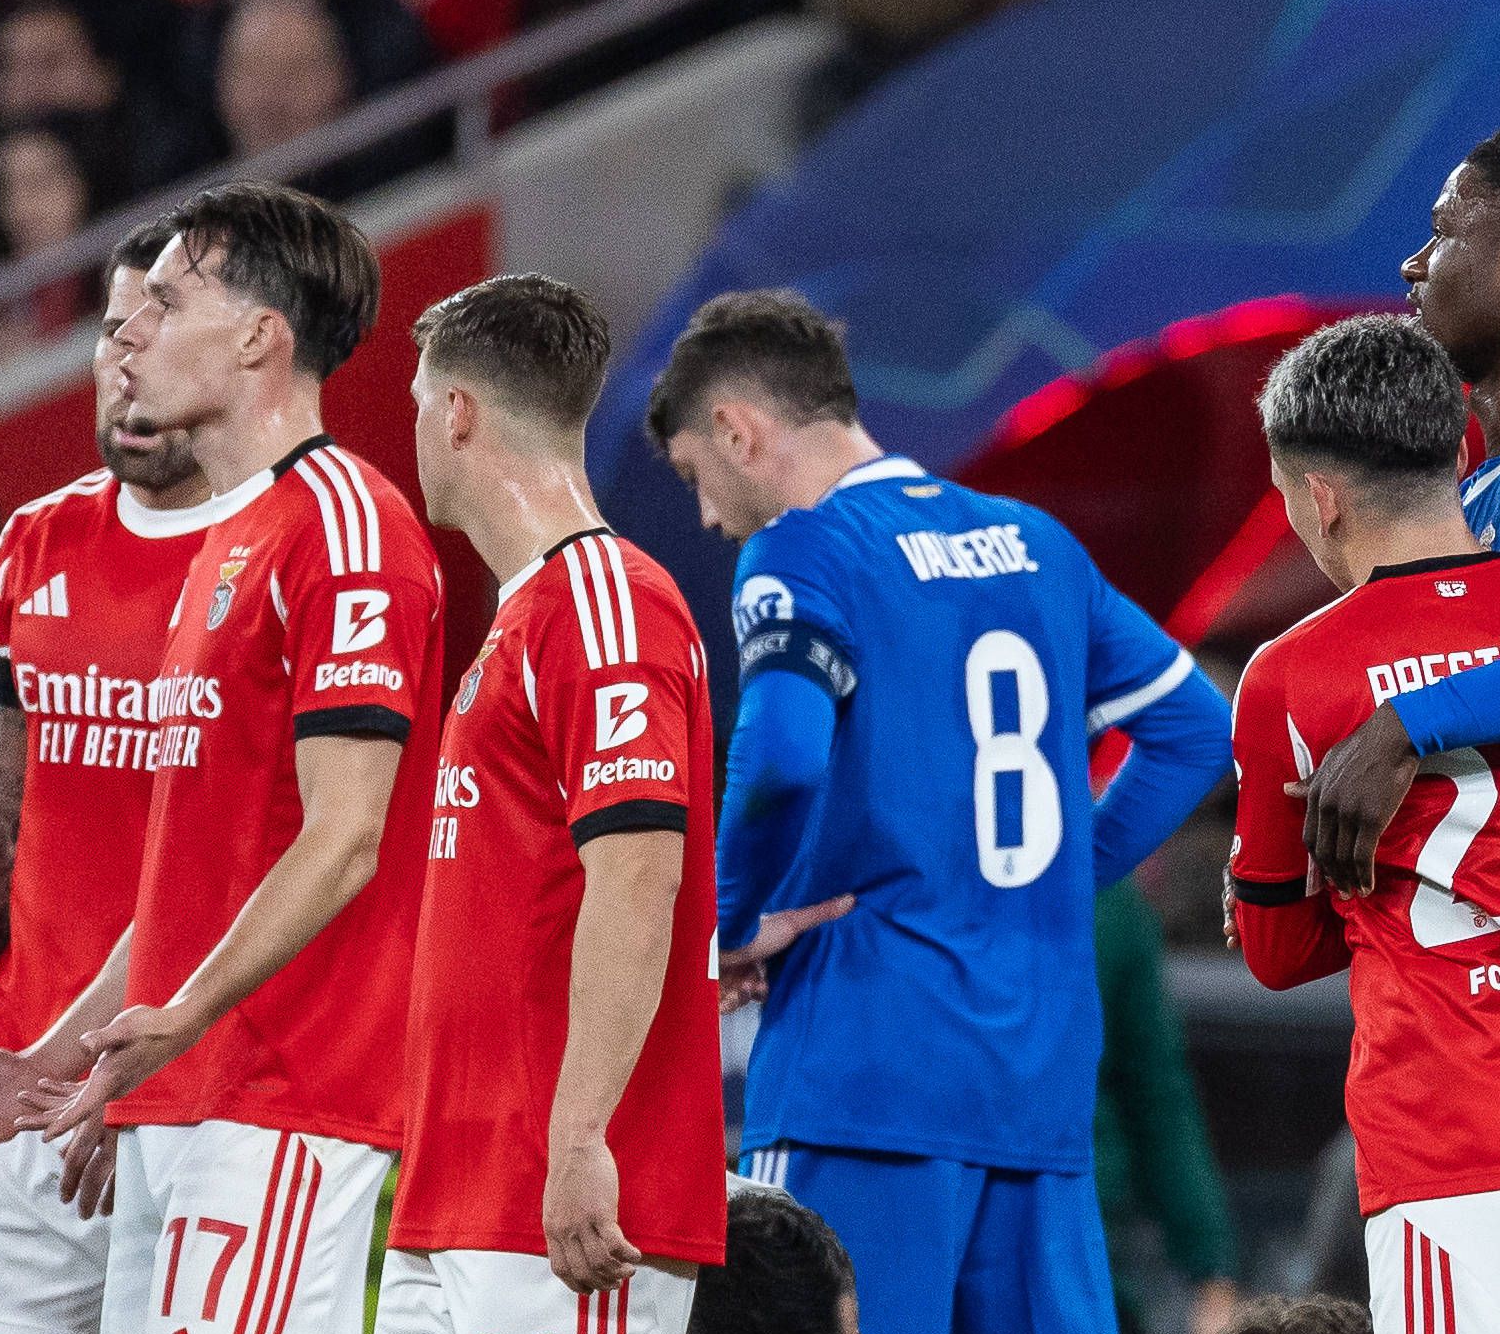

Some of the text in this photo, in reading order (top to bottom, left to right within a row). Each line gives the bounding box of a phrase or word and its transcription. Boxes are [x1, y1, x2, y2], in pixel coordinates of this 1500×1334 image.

[315, 661, 403, 692] Betano
[39, 722, 160, 772] FLY BETTE
[965, 629, 1063, 888] 8
[583, 756, 675, 792] Betano
[160, 1218, 249, 1322] 17
